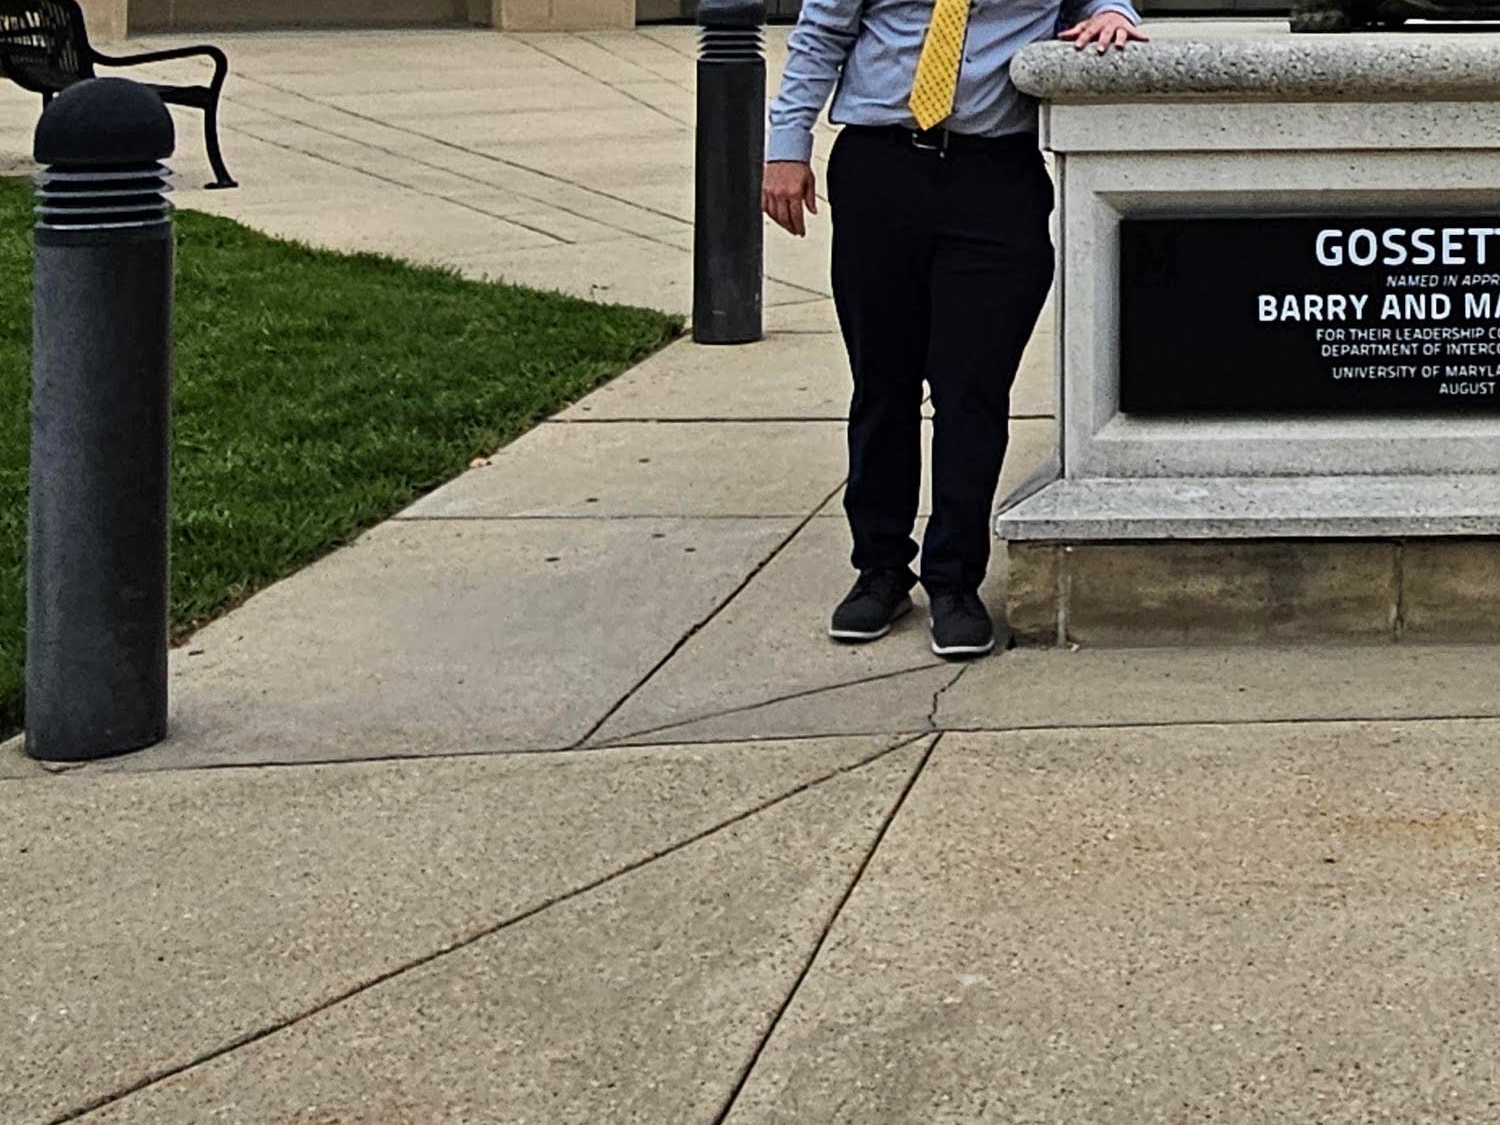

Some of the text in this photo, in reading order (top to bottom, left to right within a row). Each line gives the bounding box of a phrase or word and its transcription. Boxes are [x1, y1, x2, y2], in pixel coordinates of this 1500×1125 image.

[1387, 275, 1438, 287] NAMED
[1444, 275, 1457, 286] IN
[1258, 295, 1368, 321] BARRY
[1381, 293, 1451, 319] AND
[1317, 329, 1345, 341] FOR
[1349, 329, 1391, 340] THEIR
[1396, 328, 1484, 340] LEADERSHIP
[1322, 344, 1418, 356] DEPARTMENT
[1423, 343, 1441, 355] OF
[1333, 366, 1416, 379] UNIVERSITY
[1422, 366, 1439, 377] OF
[1440, 382, 1495, 394] AUGUST
